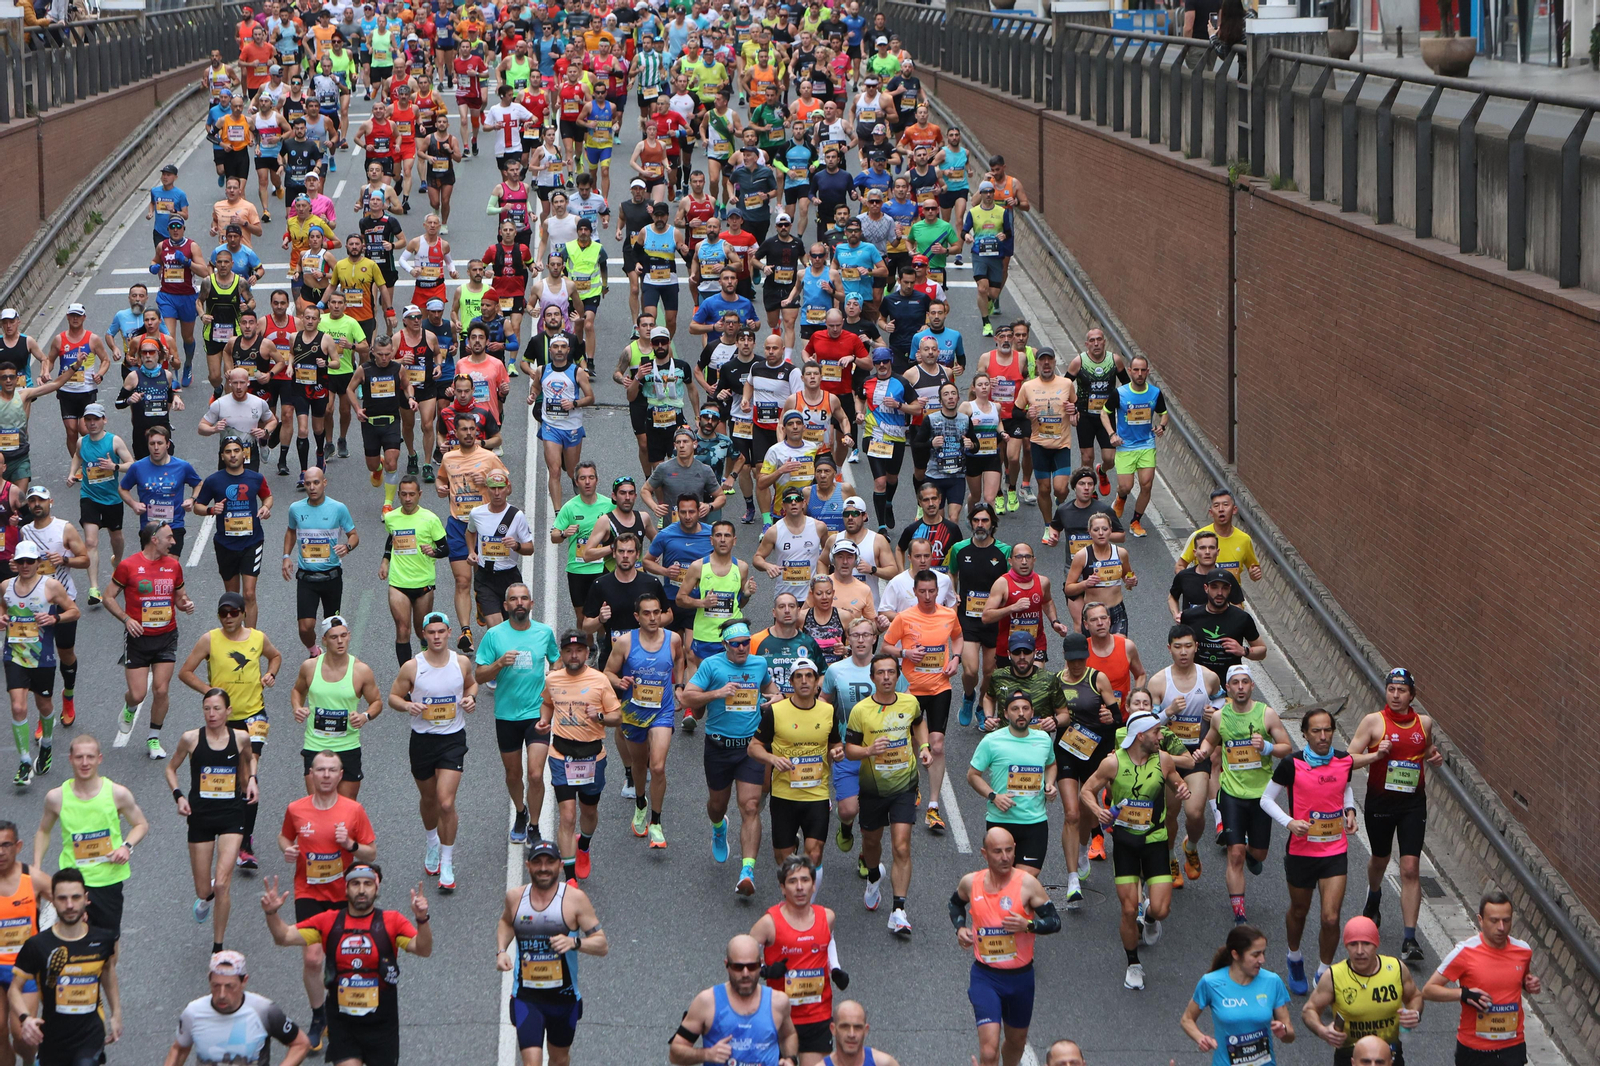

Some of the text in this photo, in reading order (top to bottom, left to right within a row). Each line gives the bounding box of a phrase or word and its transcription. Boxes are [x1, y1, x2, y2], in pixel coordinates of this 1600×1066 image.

[805, 410, 827, 421] S B
[1079, 726, 1099, 741] ZURICH
[1400, 761, 1418, 769] ZURICH
[1129, 800, 1151, 808] ZURICH
[1322, 811, 1341, 819] ZURICH
[84, 831, 107, 840] ZURICH
[316, 852, 340, 861] ZURICH
[4, 917, 29, 927] ZURICH
[799, 969, 822, 978] ZURICH
[71, 976, 96, 986] ZURICH
[350, 978, 375, 987] ZURICH
[1371, 984, 1399, 1003] 428
[1491, 1003, 1516, 1012] ZURICH
[1239, 1031, 1264, 1043] ZURICH
